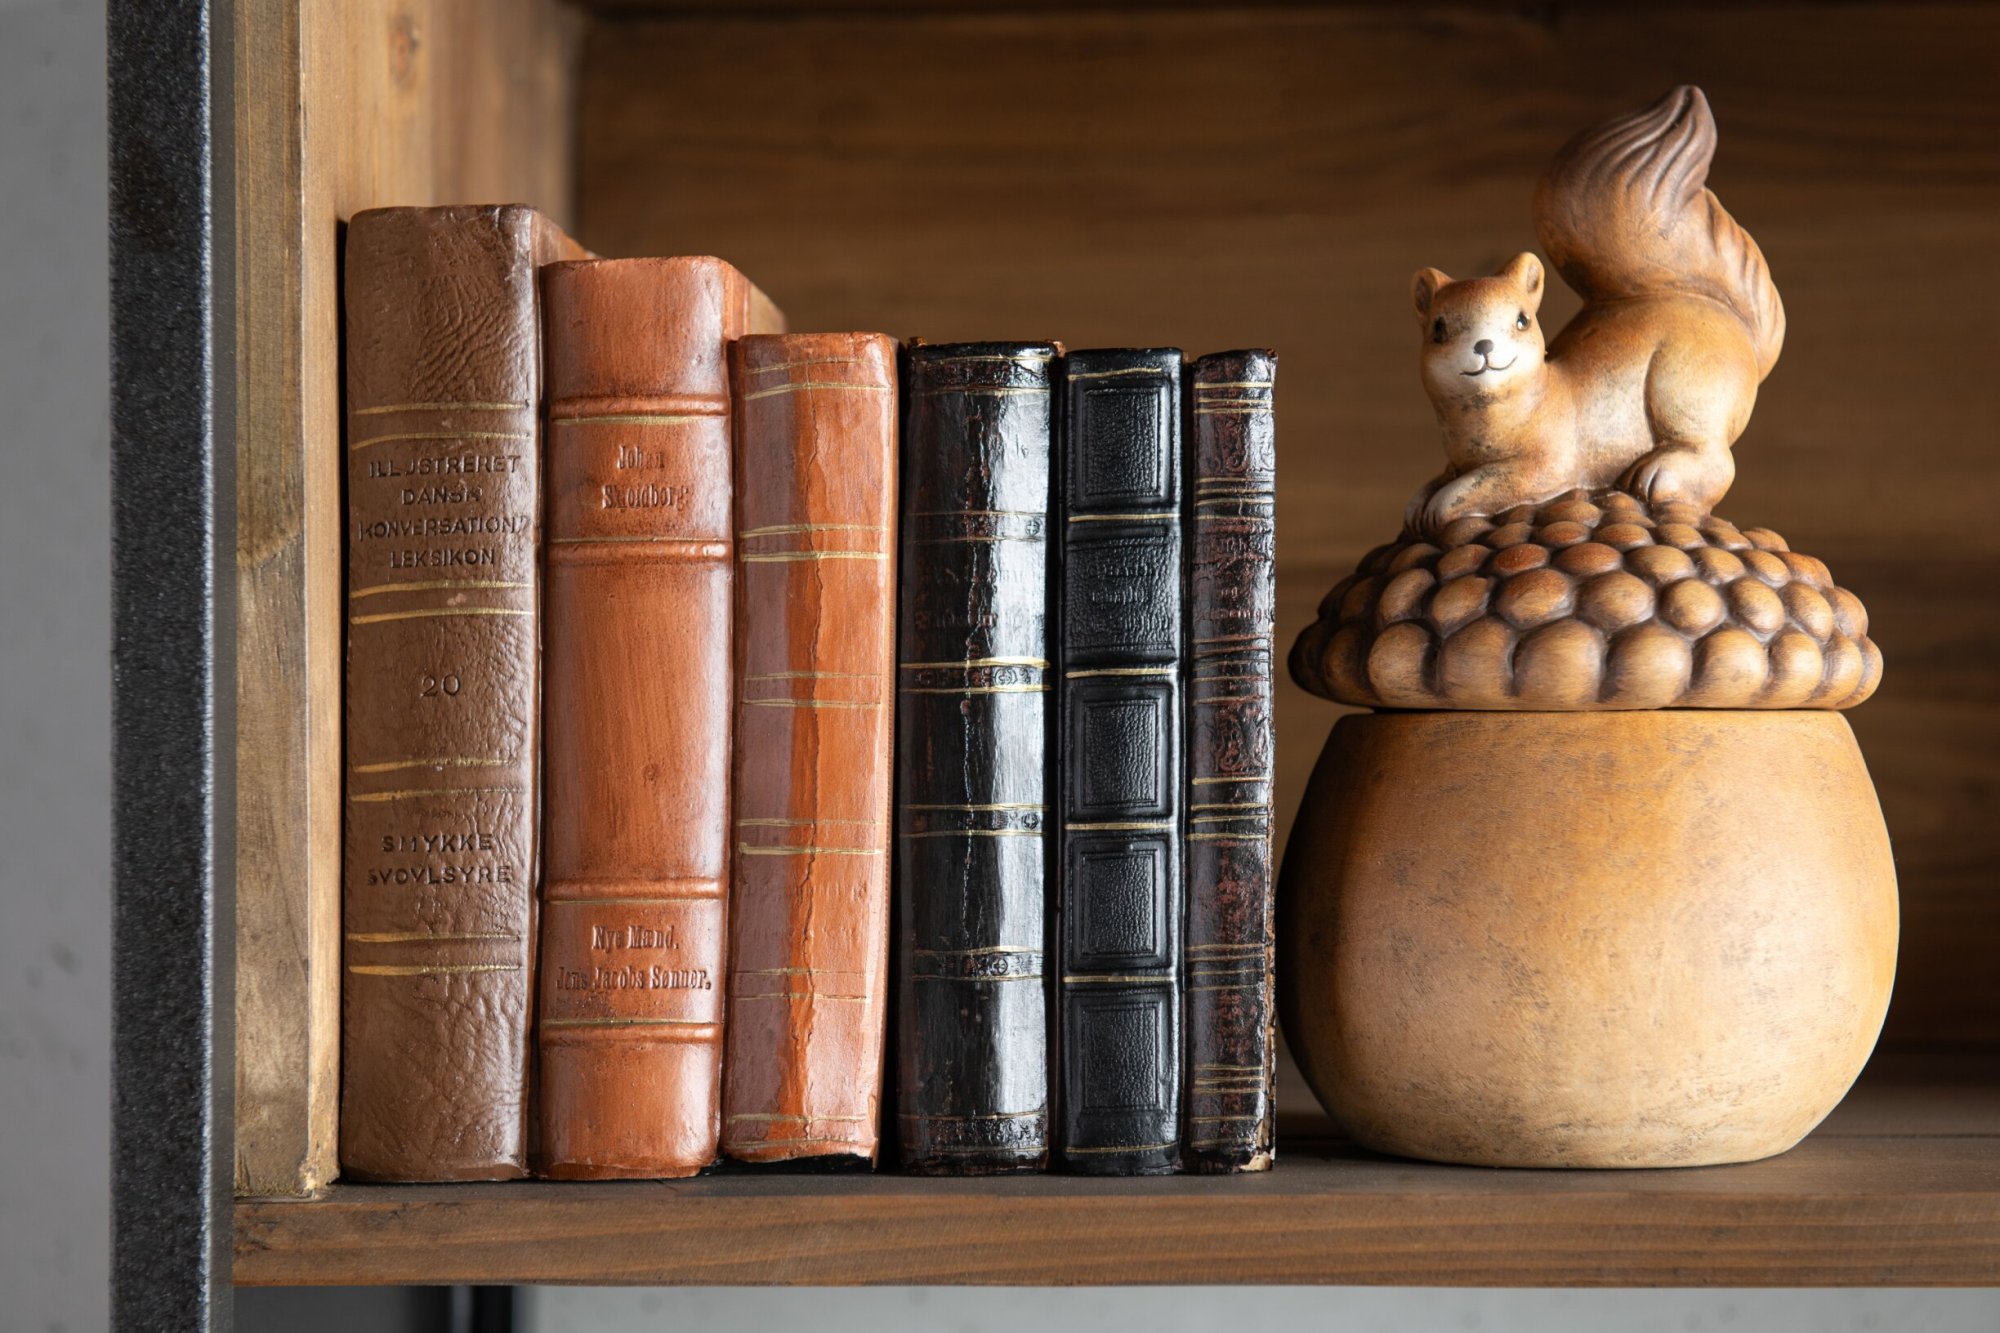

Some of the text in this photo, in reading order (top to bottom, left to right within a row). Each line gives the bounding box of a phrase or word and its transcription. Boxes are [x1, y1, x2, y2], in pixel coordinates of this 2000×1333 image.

[389, 547, 497, 570] LEKSIKON
[419, 672, 462, 698] 20
[381, 831, 494, 854] SMYKKE
[366, 863, 513, 887] SVOVLSYRE
[591, 924, 625, 953] Nye
[592, 964, 646, 991] Jacobs
